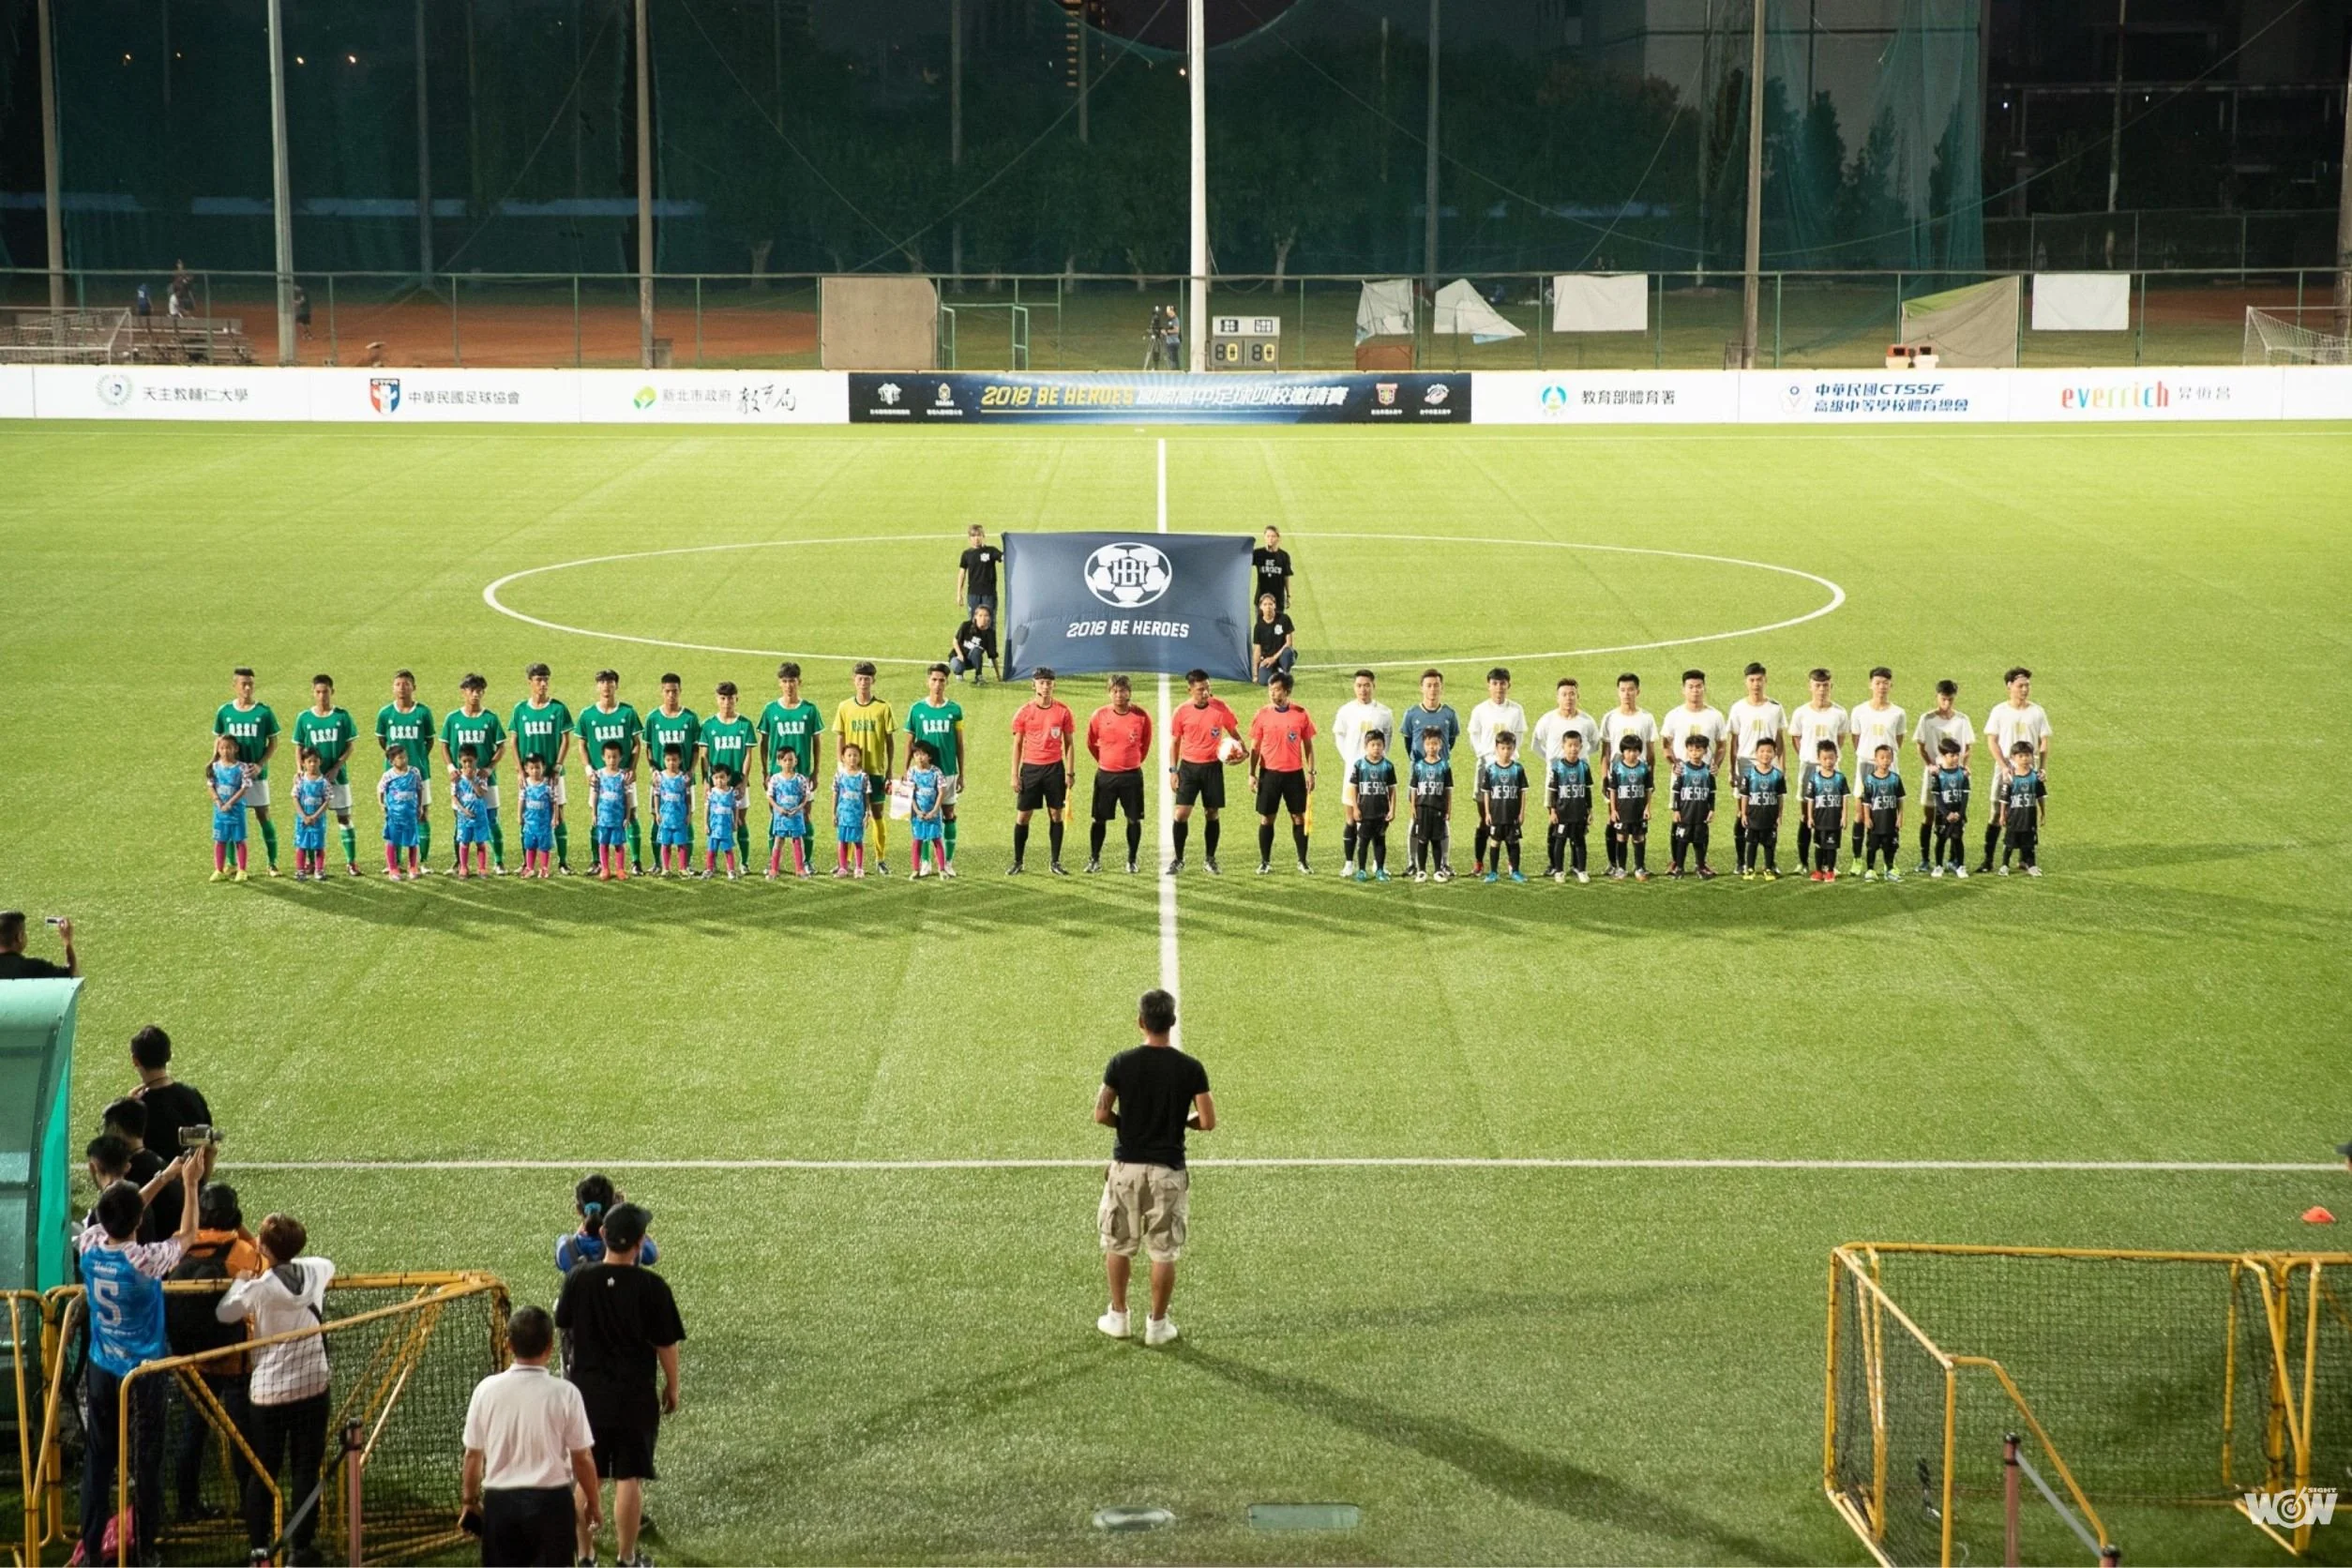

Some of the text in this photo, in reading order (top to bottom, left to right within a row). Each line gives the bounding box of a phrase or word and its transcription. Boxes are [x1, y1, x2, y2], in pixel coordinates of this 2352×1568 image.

[981, 385, 1031, 406] 2018
[1036, 385, 1059, 406] BE
[1063, 385, 1135, 406] HEROES
[2061, 381, 2169, 408] everrich
[1066, 620, 1190, 639] 2018 BE HEROES
[95, 1278, 121, 1326] 5
